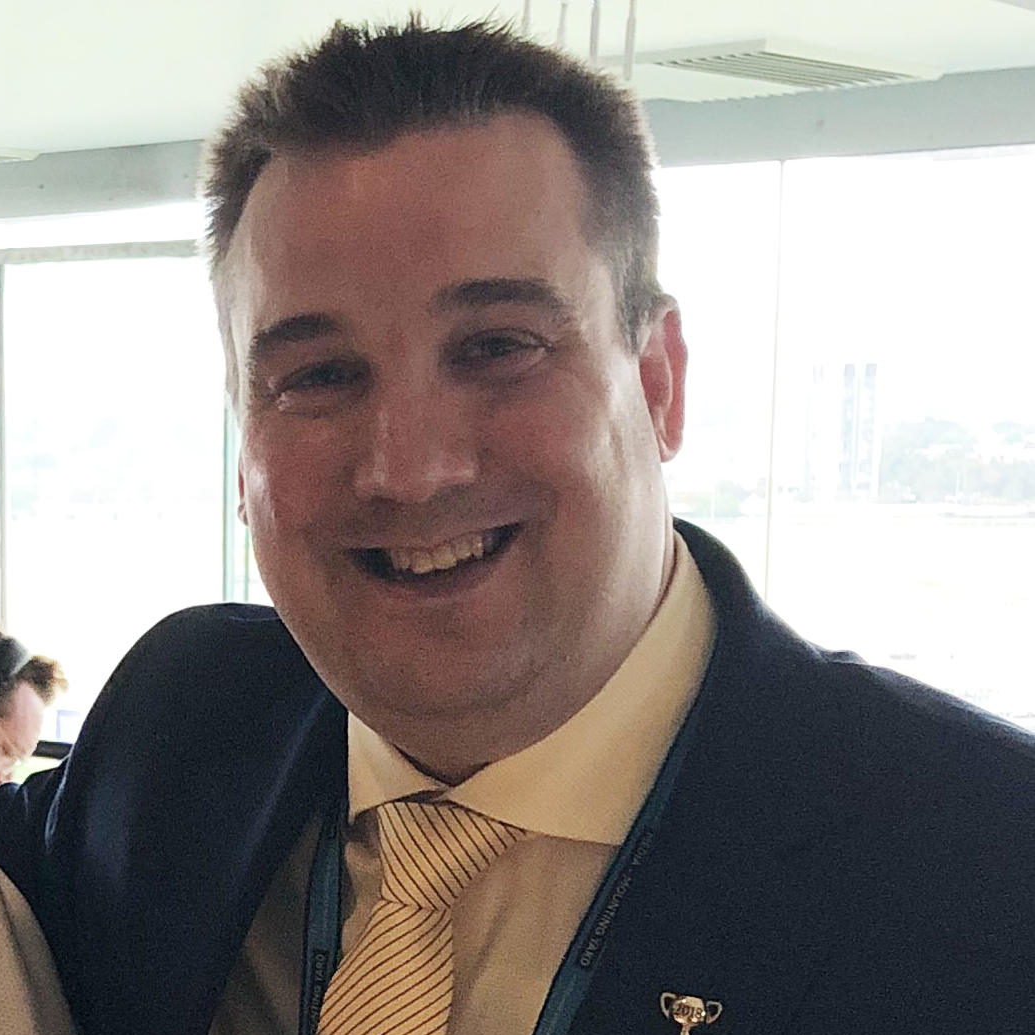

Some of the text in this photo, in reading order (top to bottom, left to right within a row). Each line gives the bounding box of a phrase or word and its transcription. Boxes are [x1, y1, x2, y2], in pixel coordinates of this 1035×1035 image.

[594, 874, 632, 936] MOUNTING
[579, 937, 600, 967] YARD
[674, 1004, 703, 1020] 2018
